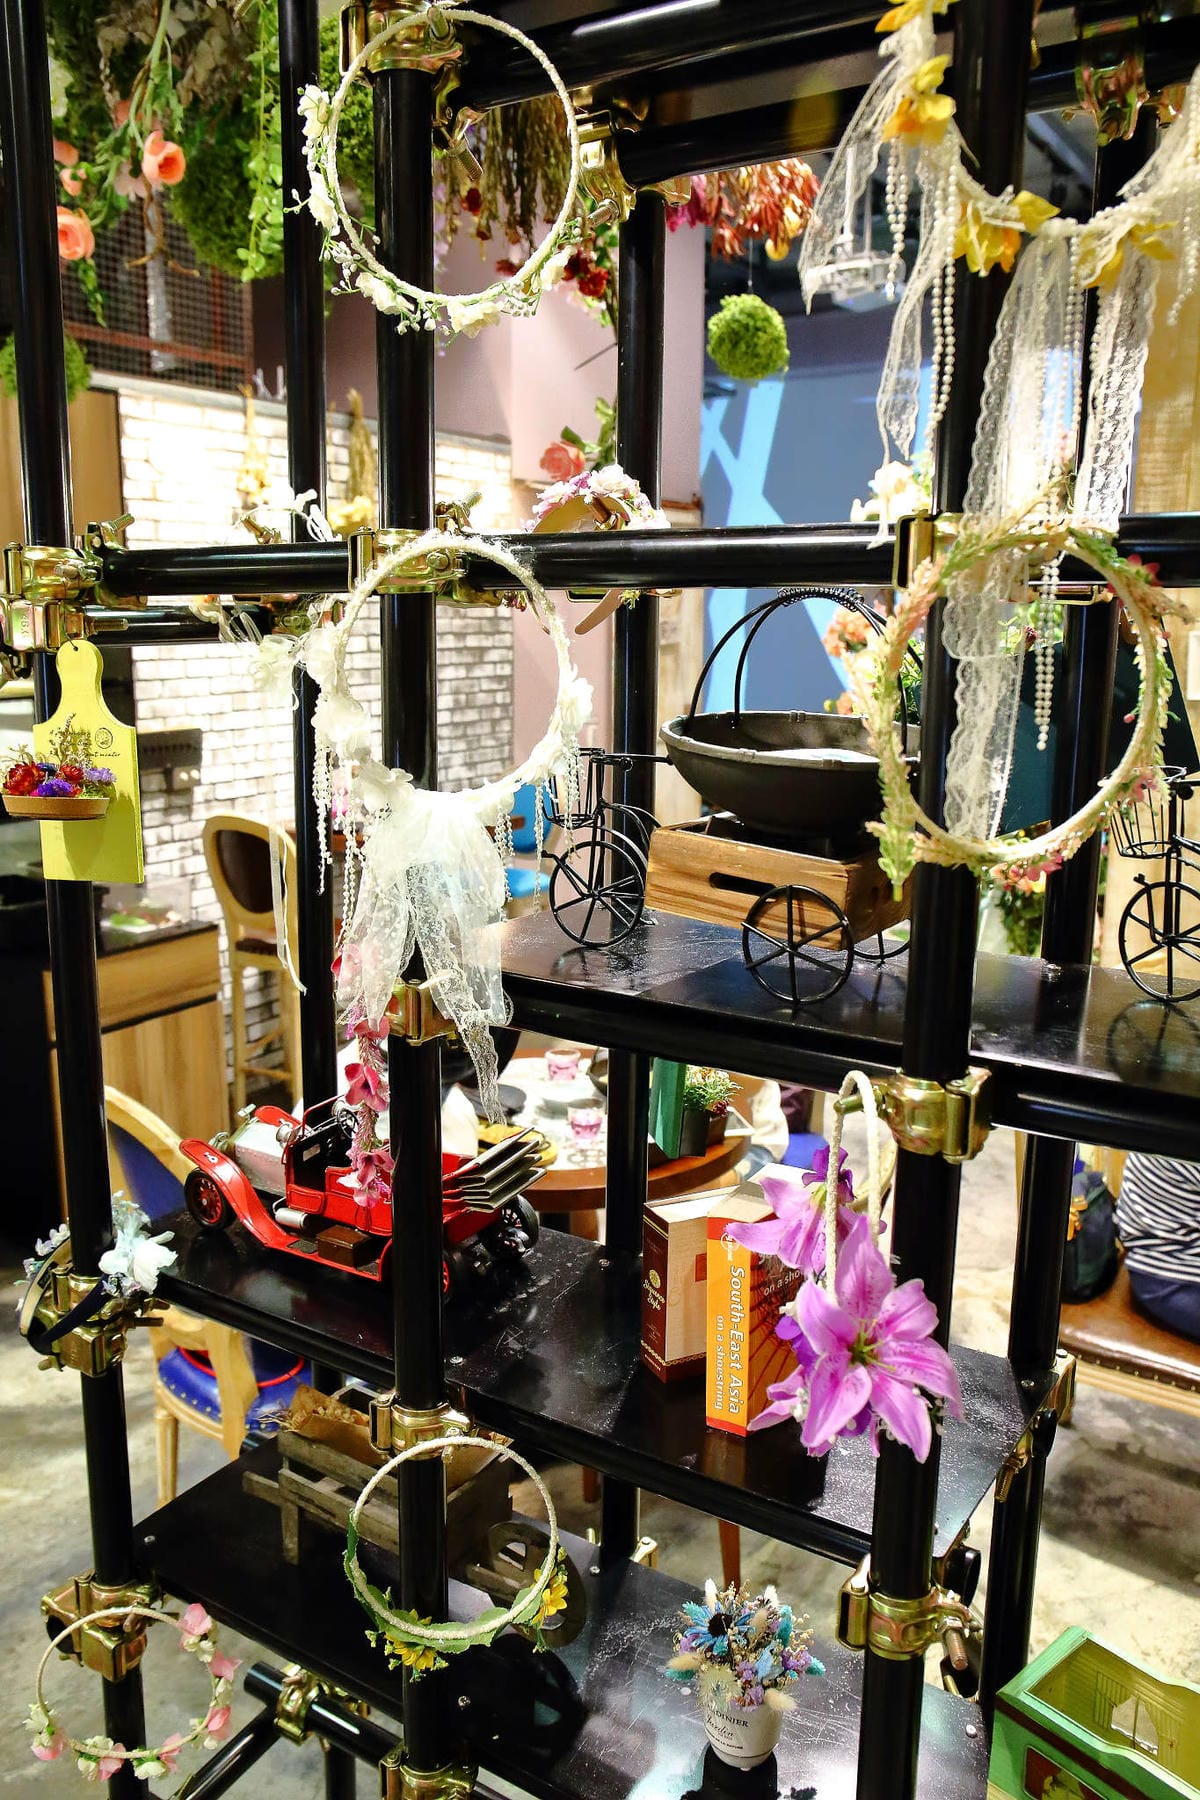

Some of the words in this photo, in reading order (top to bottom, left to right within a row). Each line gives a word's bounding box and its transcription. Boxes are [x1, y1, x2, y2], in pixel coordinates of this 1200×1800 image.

[763, 1285, 775, 1296] on
[777, 1280, 783, 1288] a
[716, 1315, 725, 1331] on
[729, 1265, 746, 1370] South-East
[714, 1346, 726, 1410] shoestring
[728, 1374, 744, 1414] Asia
